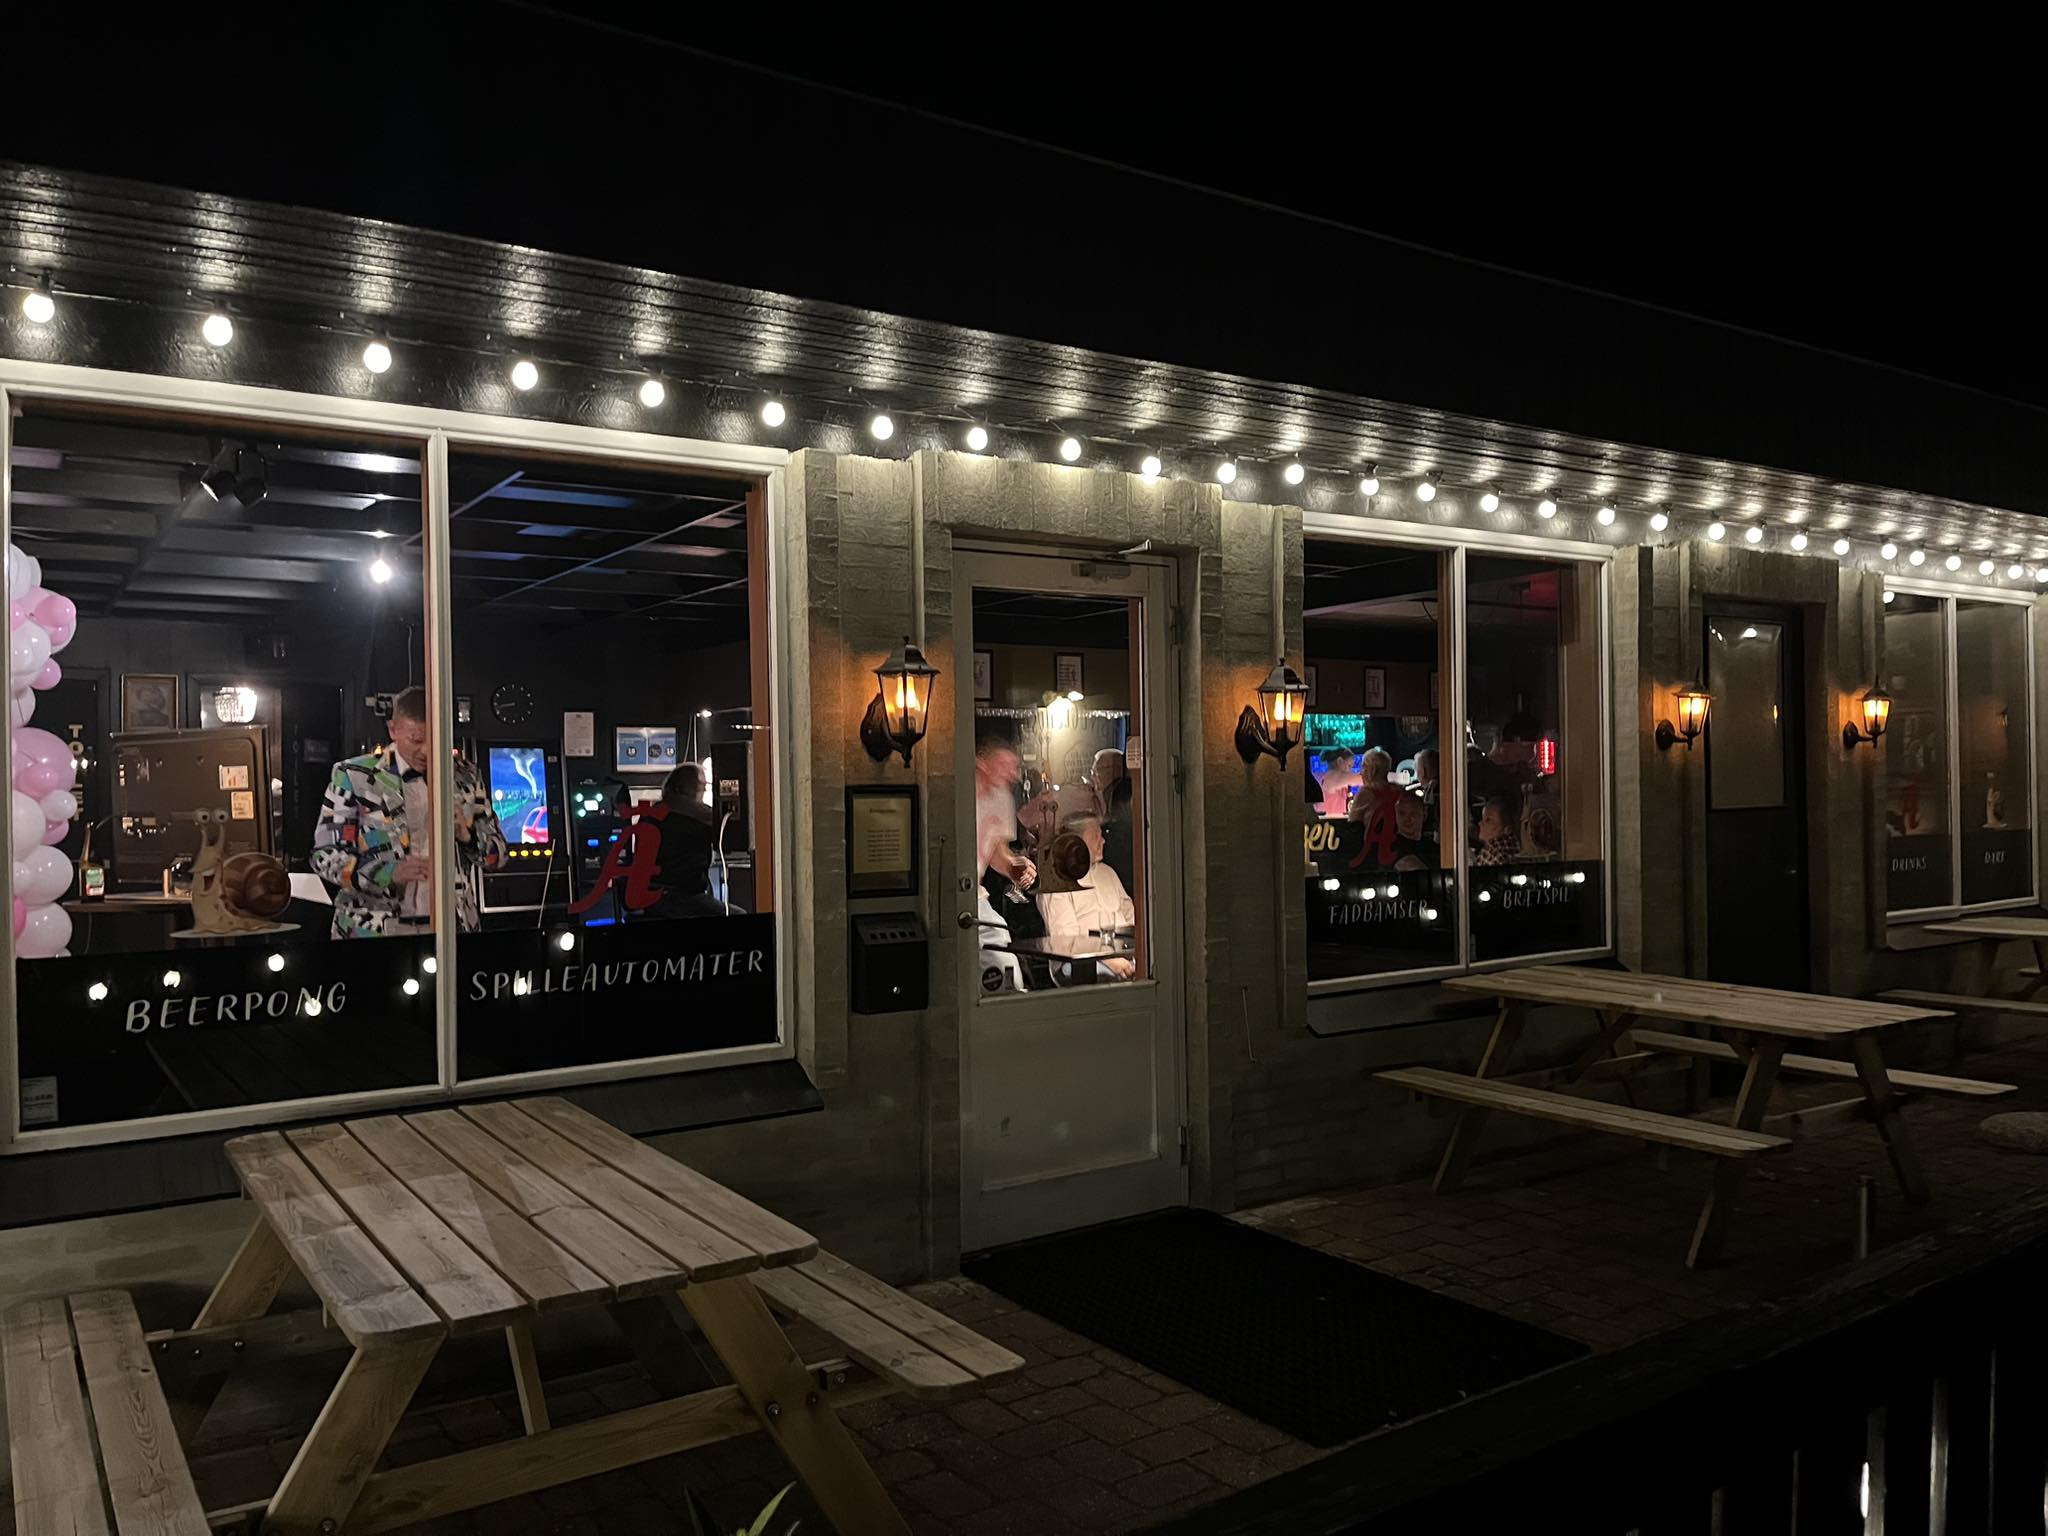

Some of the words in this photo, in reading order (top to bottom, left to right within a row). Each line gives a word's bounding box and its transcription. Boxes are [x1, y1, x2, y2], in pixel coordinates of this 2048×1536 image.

[1891, 856, 1927, 872] DRINKS
[1503, 886, 1569, 909] BRÆTSPIL
[1328, 898, 1429, 925] FADBAMSER
[469, 949, 763, 1002] SPILLEAUTOMATER
[125, 981, 347, 1034] BEERPONG
